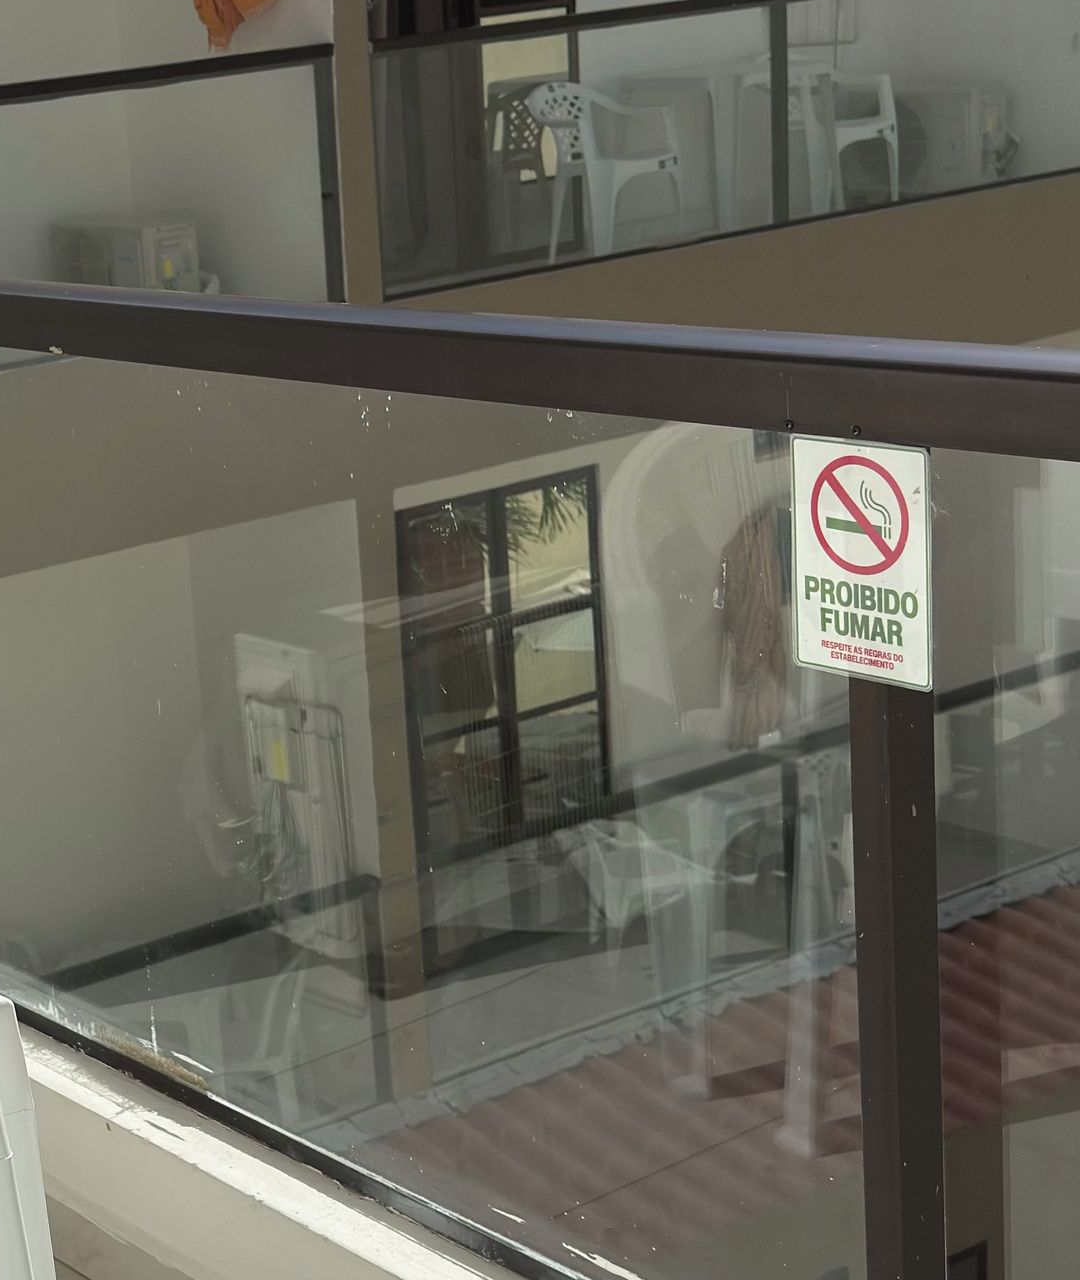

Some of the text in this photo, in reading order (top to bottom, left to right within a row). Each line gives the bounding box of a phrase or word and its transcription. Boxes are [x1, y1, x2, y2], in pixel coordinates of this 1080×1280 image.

[805, 575, 918, 619] PROIBIDO
[820, 607, 903, 647] FUMAR
[821, 640, 904, 663] RESPEITE AS REGRAS DO
[830, 651, 895, 671] ESTABELECIMENTO
